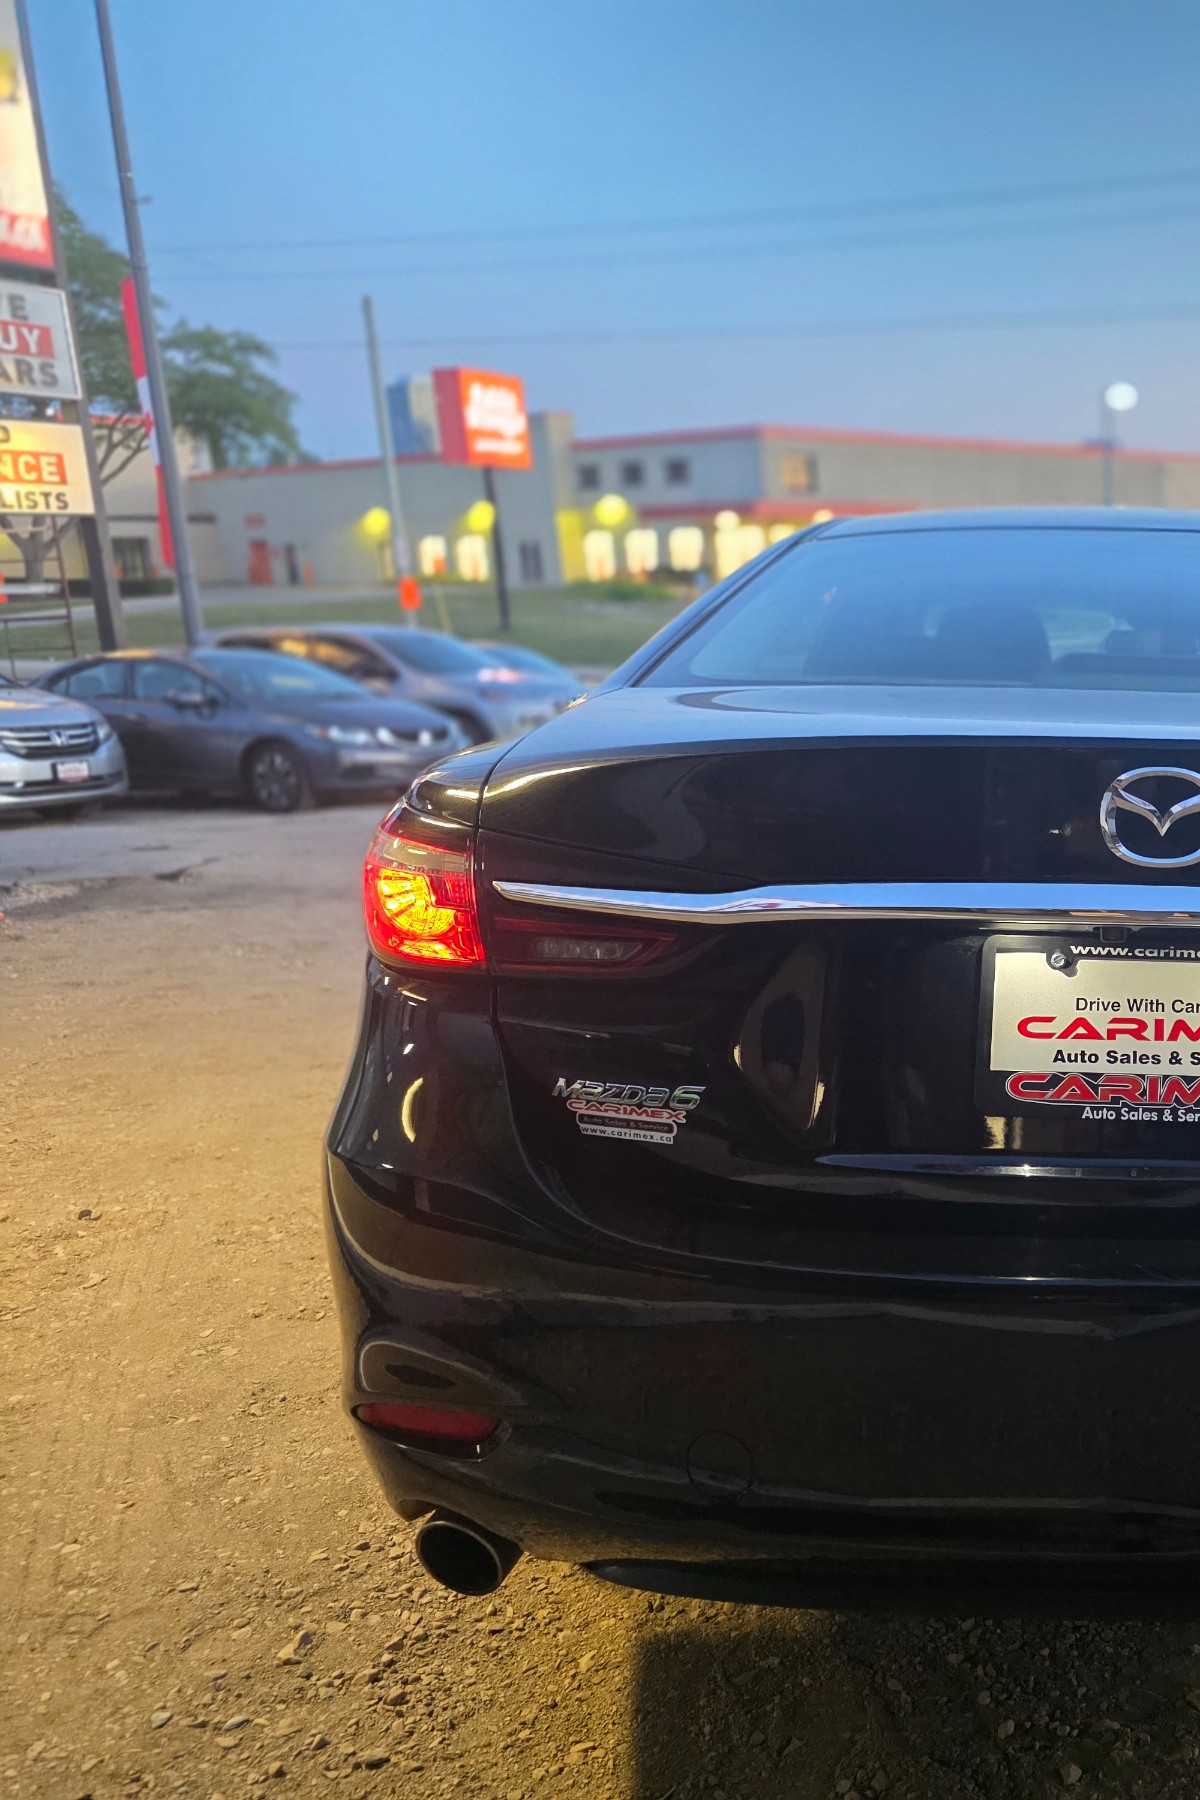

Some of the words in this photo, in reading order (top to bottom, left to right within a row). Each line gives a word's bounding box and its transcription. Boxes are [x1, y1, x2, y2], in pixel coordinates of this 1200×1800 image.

[1075, 997, 1121, 1012] Drive
[1126, 998, 1165, 1014] With
[1052, 1049, 1099, 1064] Auto
[1106, 1049, 1162, 1066] Sales
[1168, 1050, 1183, 1066] &
[568, 1100, 685, 1122] CARIMEX
[1081, 1106, 1117, 1120] Auto
[1120, 1107, 1159, 1122] Sales
[1162, 1109, 1174, 1122] &
[581, 1126, 672, 1142] www.carimex.ca
